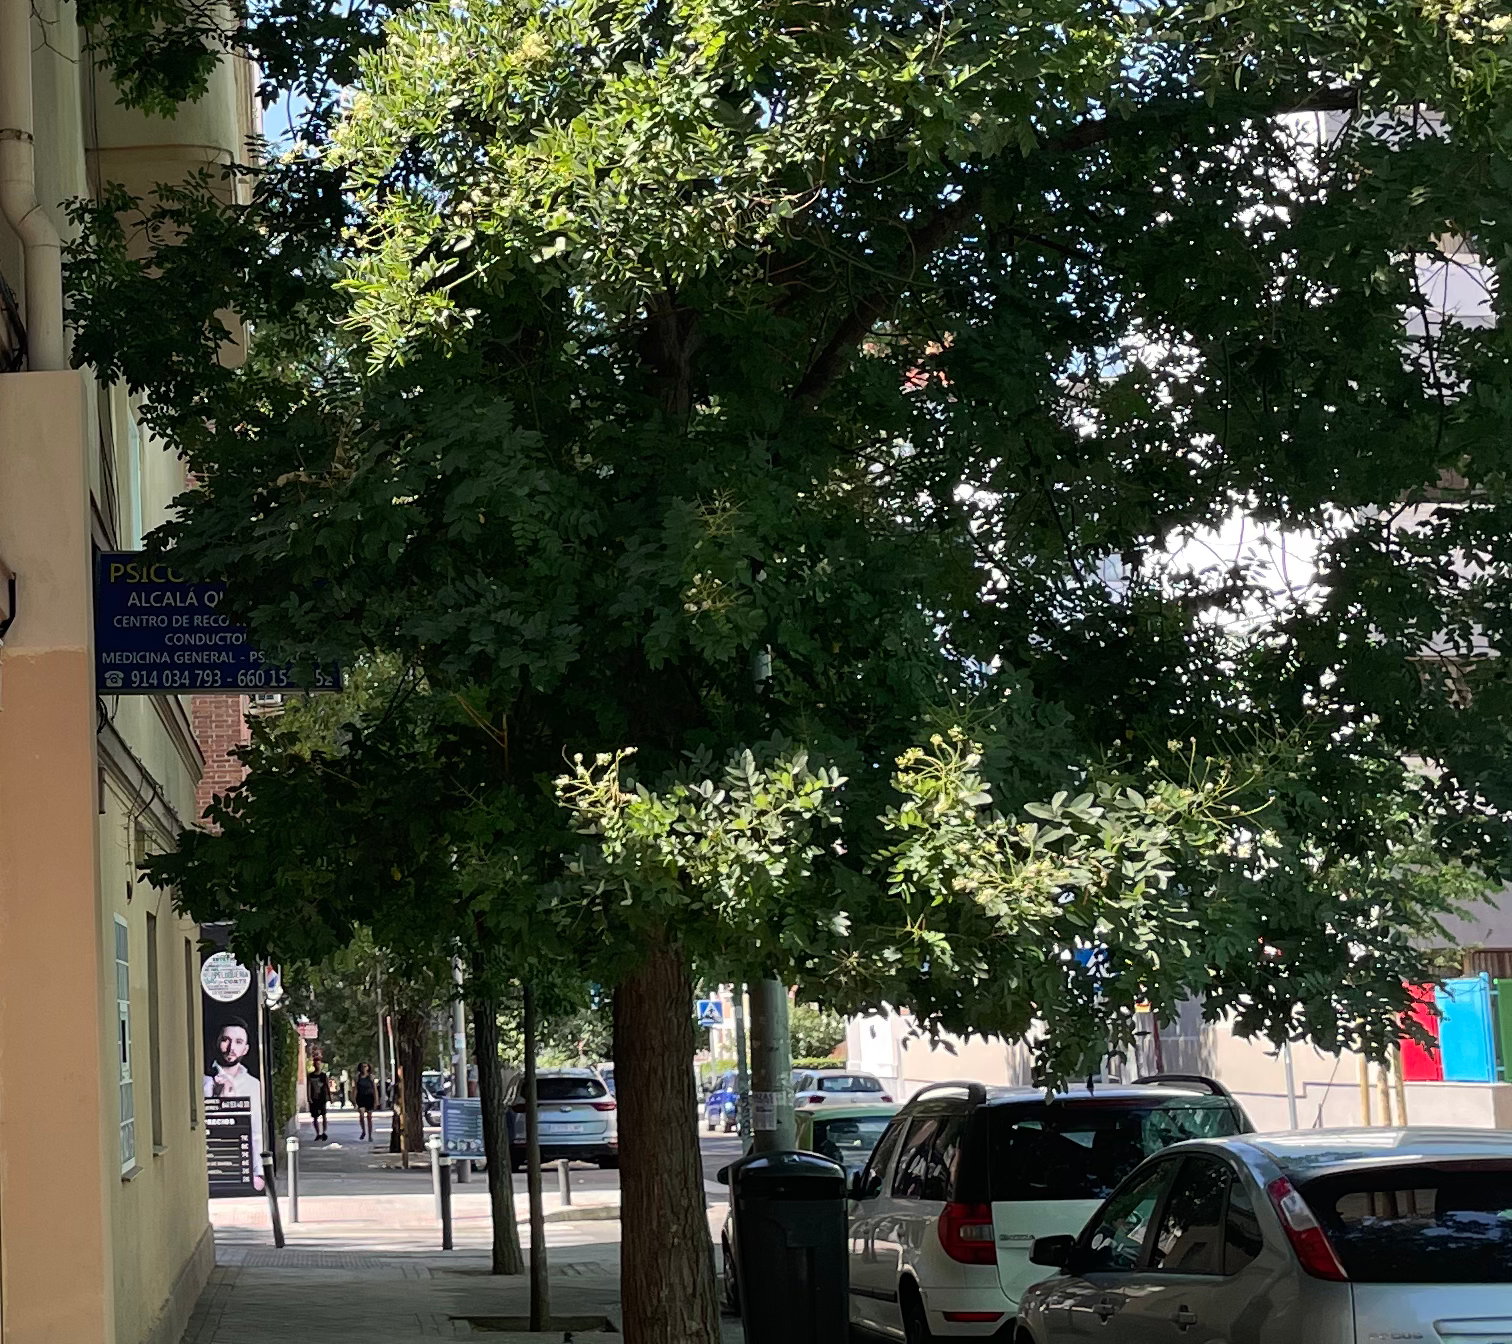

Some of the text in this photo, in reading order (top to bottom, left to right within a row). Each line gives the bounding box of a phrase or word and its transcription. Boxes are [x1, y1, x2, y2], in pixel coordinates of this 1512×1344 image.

[128, 587, 198, 607] ALCALÁ
[113, 615, 168, 627] CENTRO
[172, 615, 189, 627] DE
[165, 633, 247, 645] CONDUCTO
[102, 652, 170, 664] MEDICINA
[174, 651, 236, 663] GENERAL
[131, 670, 158, 687] 914
[162, 670, 189, 687] 034
[194, 669, 221, 687] 793
[238, 669, 265, 687] 660
[270, 669, 287, 686] 15
